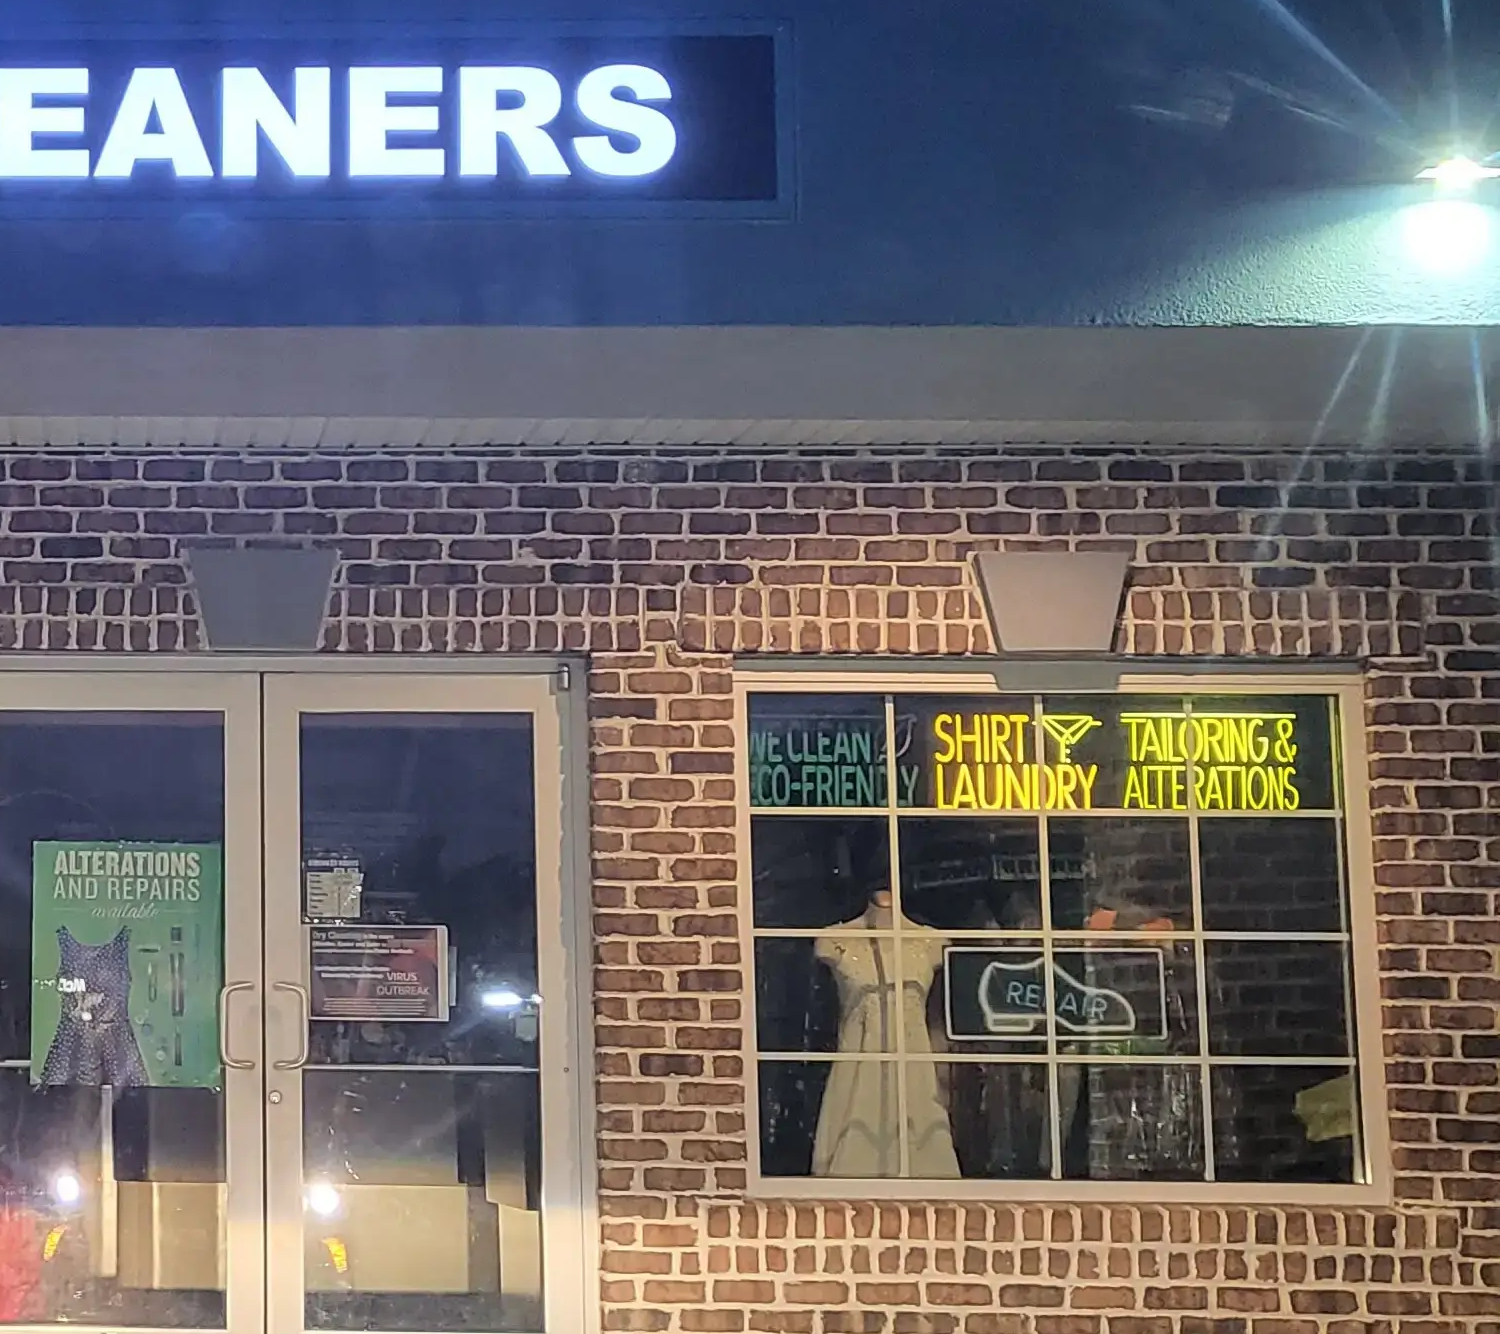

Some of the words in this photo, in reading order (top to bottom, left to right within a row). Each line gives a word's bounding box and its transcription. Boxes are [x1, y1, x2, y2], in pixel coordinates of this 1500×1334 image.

[787, 719, 871, 763] CLEAN
[935, 713, 1029, 763] SHIRT
[1120, 717, 1269, 763] TAILORING
[1275, 718, 1297, 763] &
[937, 763, 1097, 810] LAUNDRY
[1123, 765, 1300, 810] ALTERATIONS
[54, 850, 201, 877] ALTERATIONS
[54, 877, 98, 900] AND
[107, 878, 201, 902] REPAIRS
[92, 902, 161, 919] available
[375, 985, 429, 996] OUTBREAK
[386, 971, 418, 982] VIRUS
[1006, 980, 1108, 1022] REAIR
